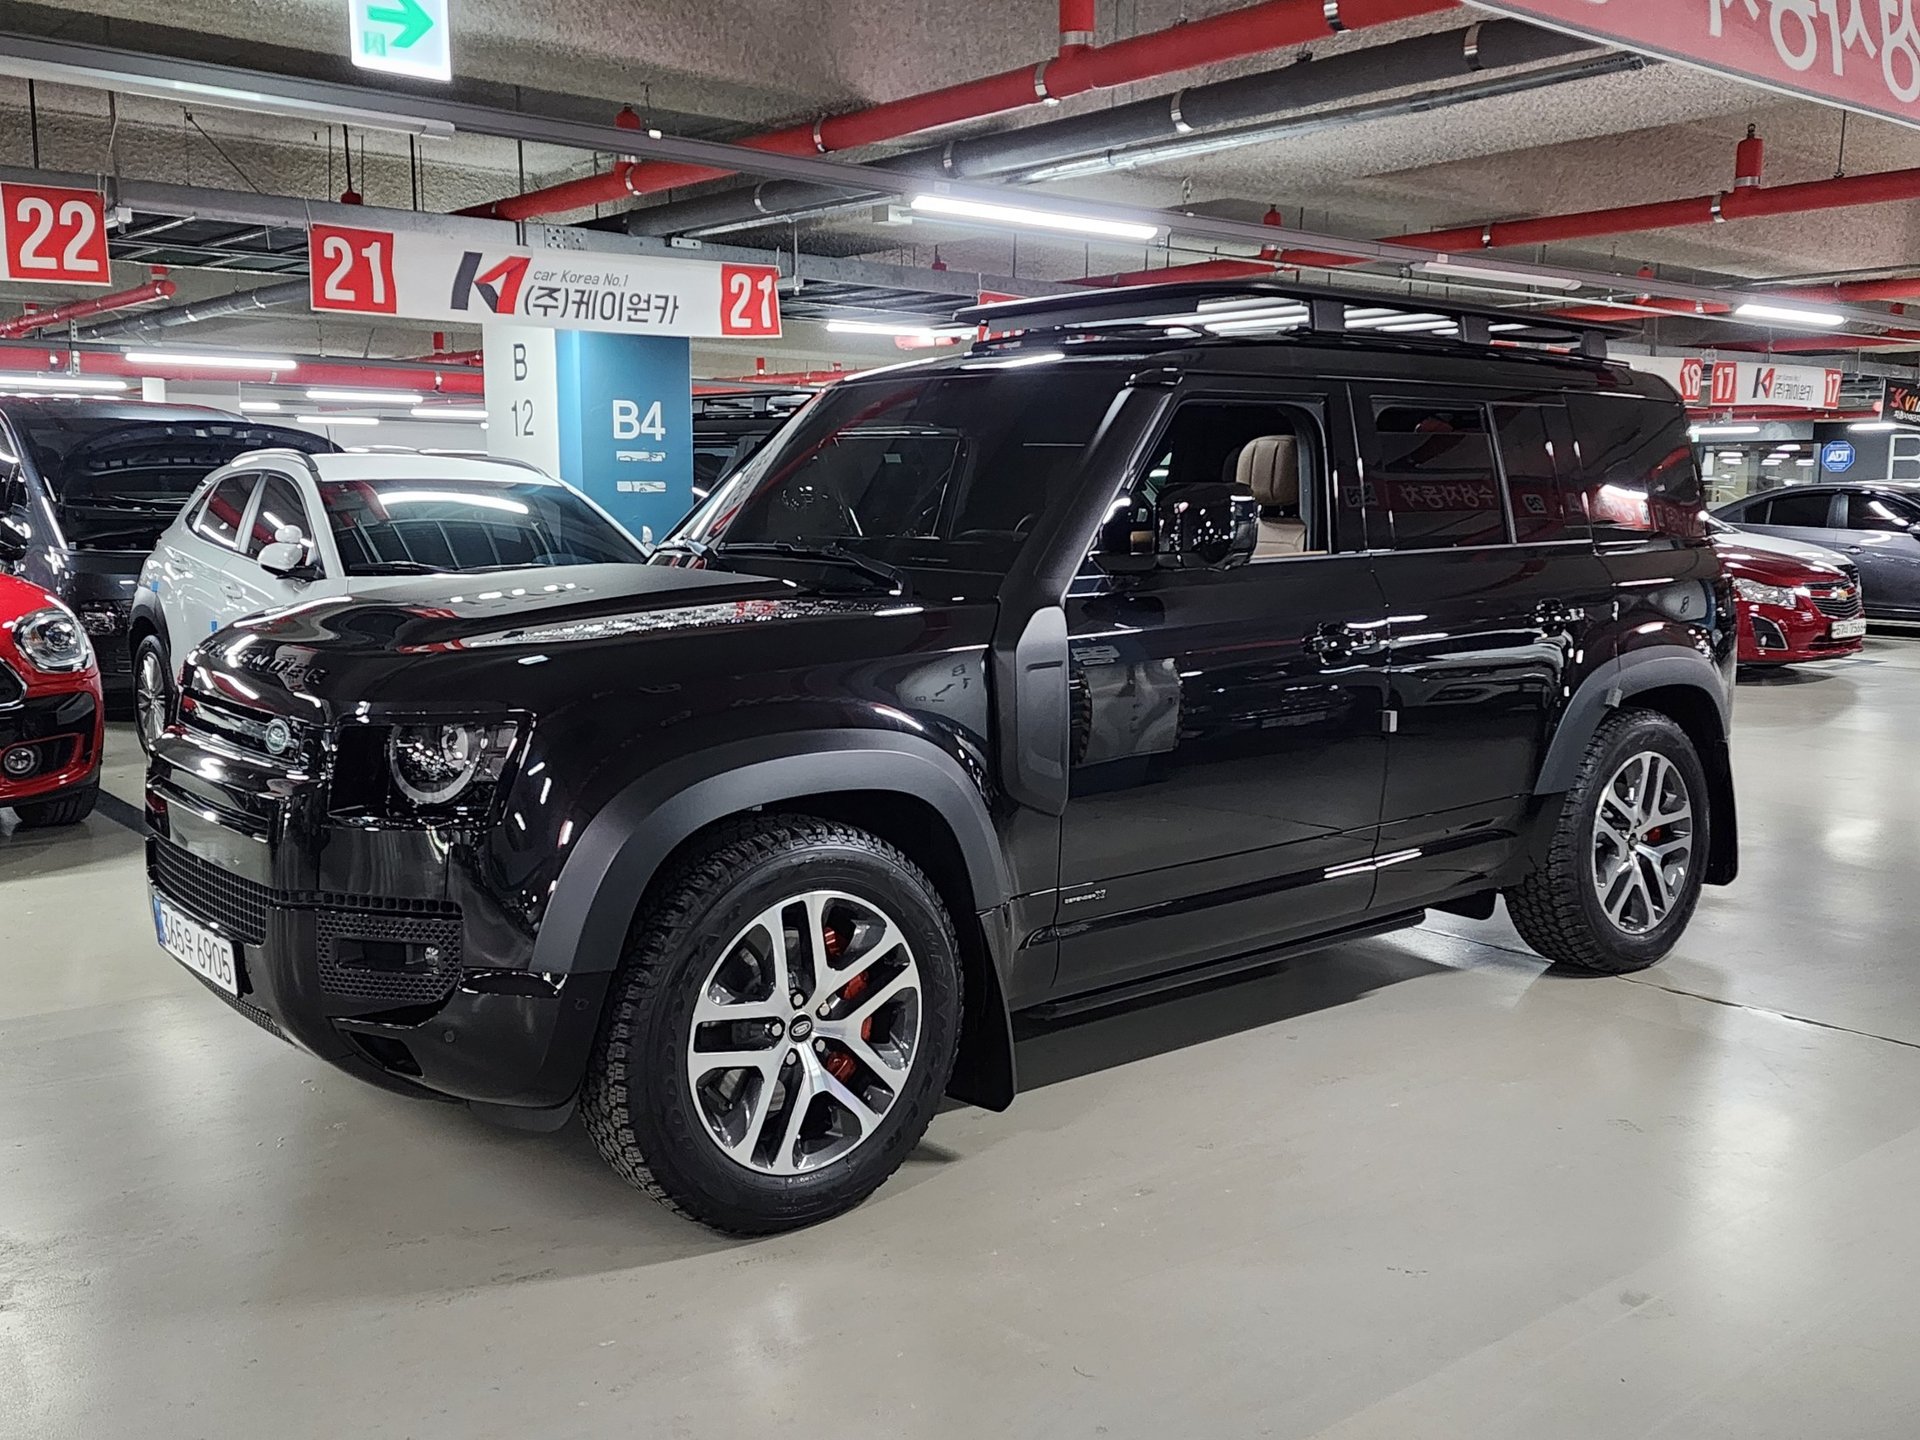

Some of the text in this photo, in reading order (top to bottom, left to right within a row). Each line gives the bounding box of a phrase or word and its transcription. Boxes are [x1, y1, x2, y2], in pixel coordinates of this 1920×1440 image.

[17, 197, 99, 272] 22
[323, 236, 385, 304] 21
[533, 270, 629, 288] car Korea No.1
[524, 284, 679, 324] (주)케이원카
[730, 273, 772, 328] 21
[513, 343, 528, 381] B
[1683, 363, 1702, 396] 18
[1716, 367, 1735, 399] 17
[1826, 373, 1840, 403] 17
[511, 399, 534, 437] 12
[612, 399, 666, 441] B4
[1825, 450, 1850, 462] ADT
[197, 932, 232, 985] 6905
